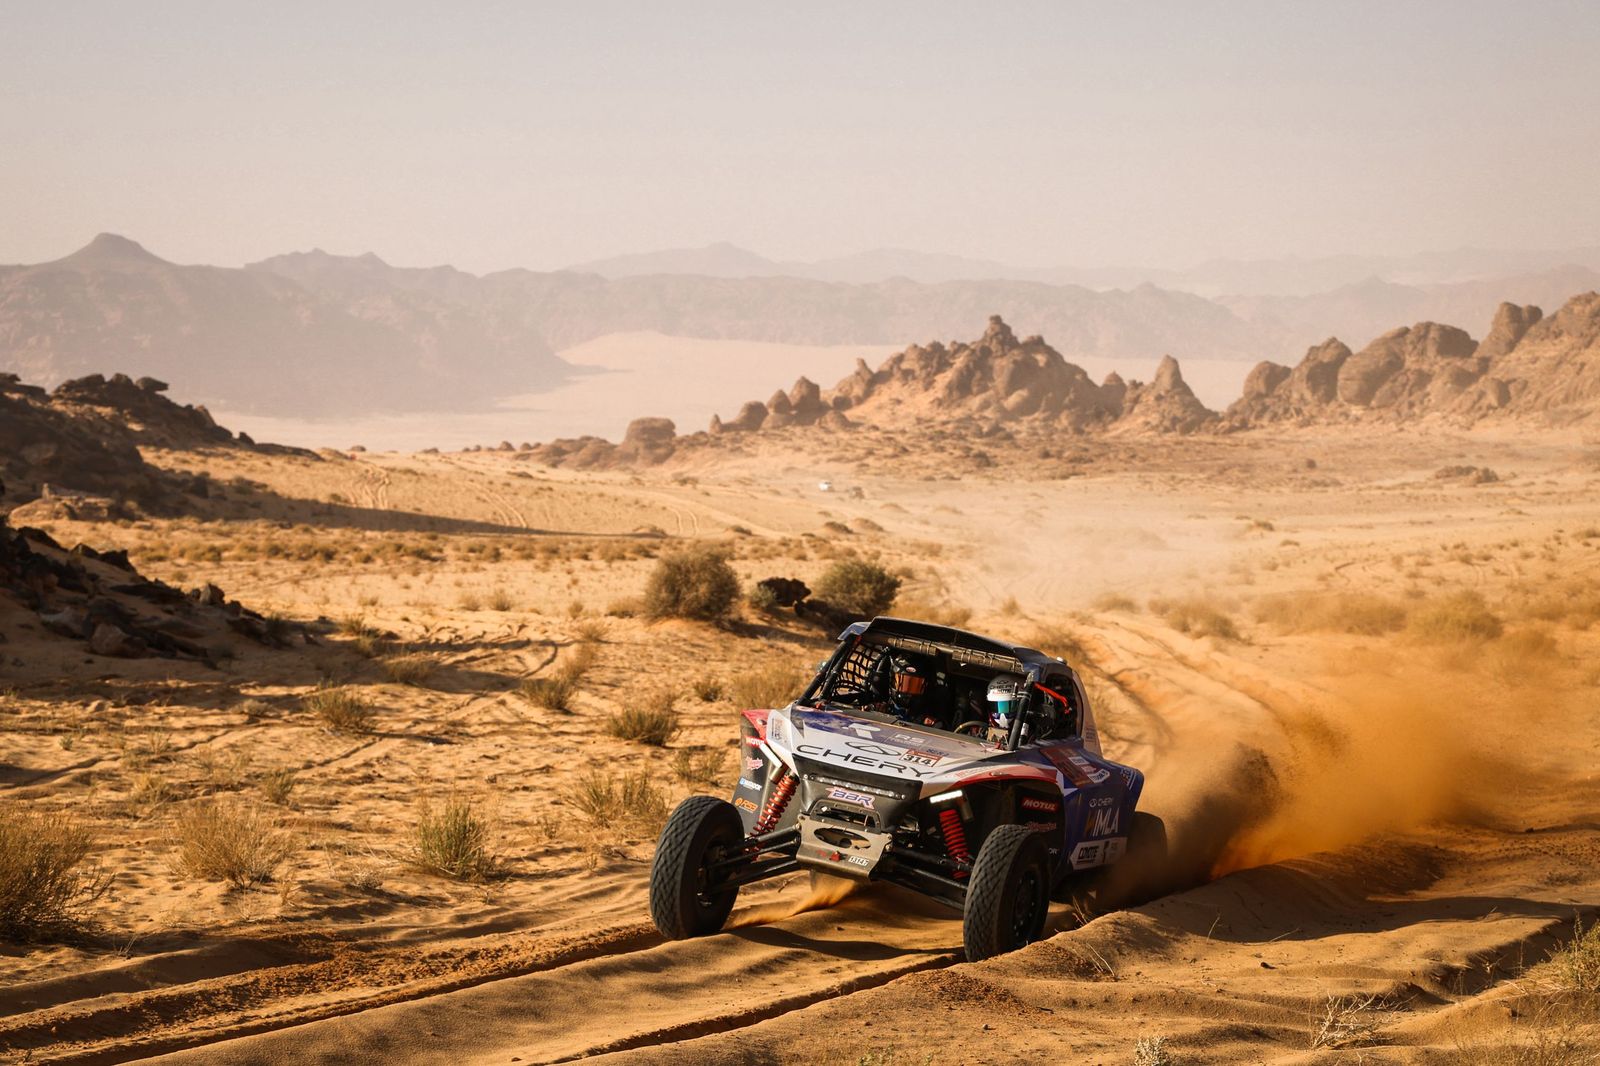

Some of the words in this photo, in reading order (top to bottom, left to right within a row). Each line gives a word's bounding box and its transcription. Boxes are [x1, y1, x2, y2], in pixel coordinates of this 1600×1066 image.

[796, 744, 936, 778] CHERY
[903, 754, 932, 766] 314
[832, 789, 873, 806] BBR
[1023, 799, 1057, 811] MOTUL
